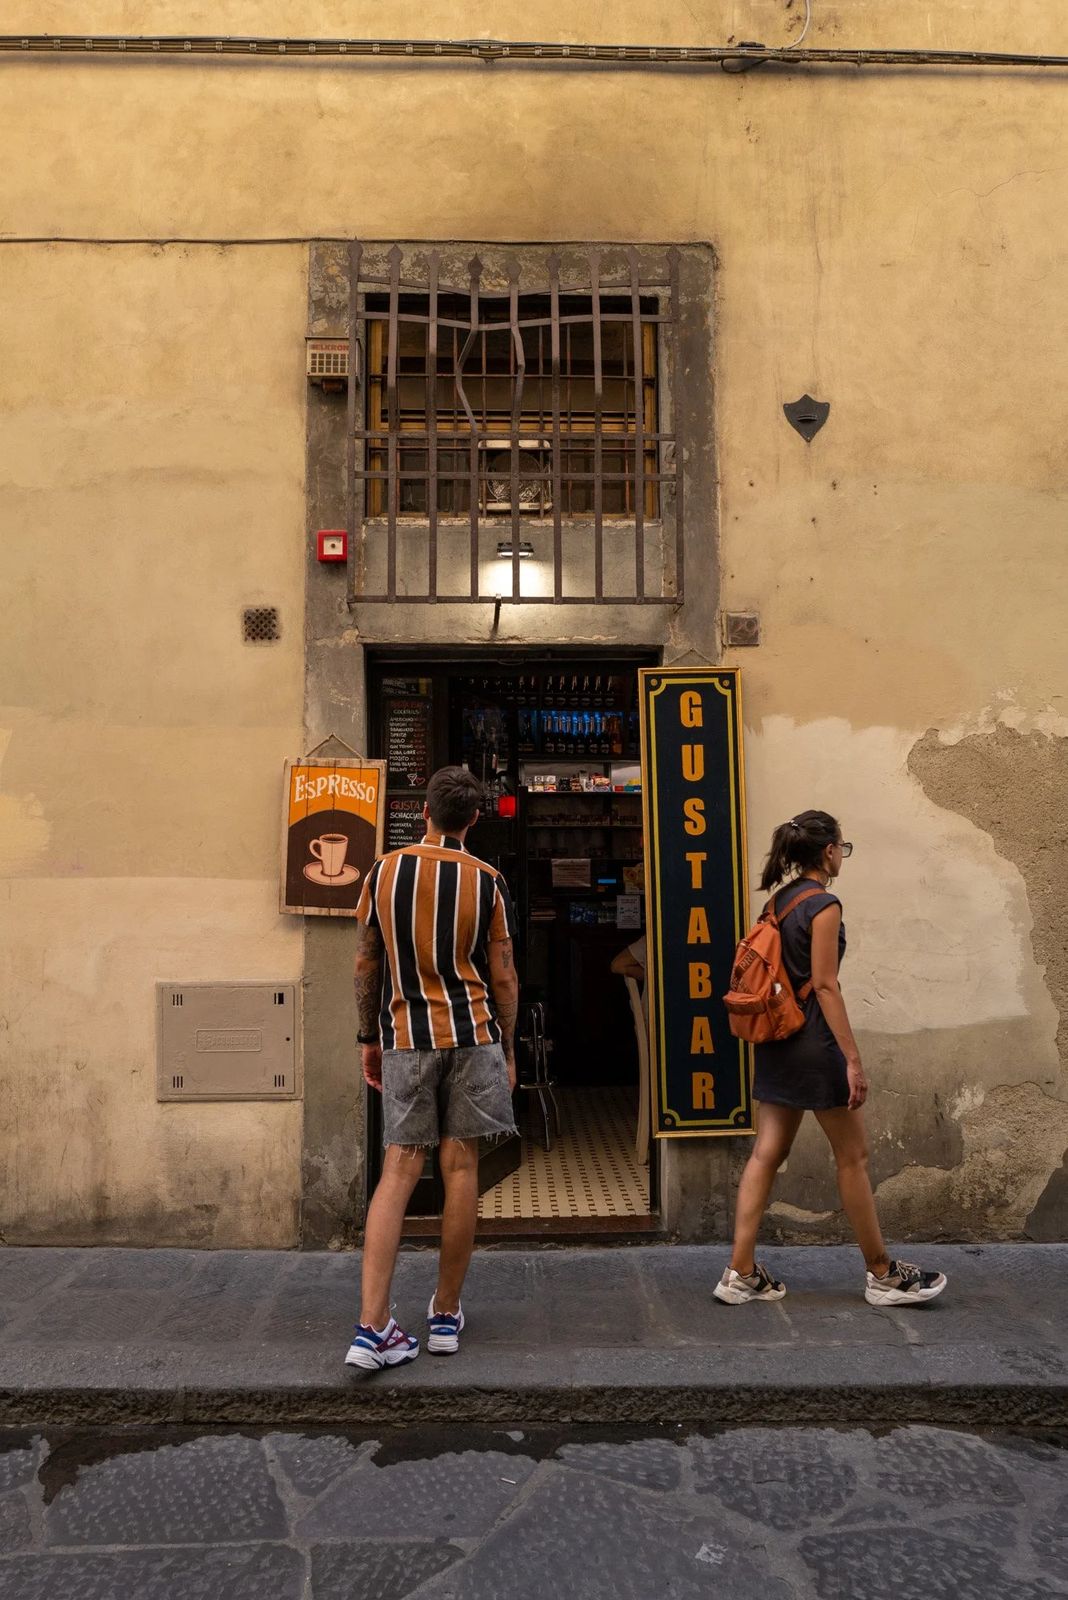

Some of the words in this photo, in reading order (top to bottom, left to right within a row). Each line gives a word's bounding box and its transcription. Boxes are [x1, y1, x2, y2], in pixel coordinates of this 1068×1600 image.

[294, 773, 376, 804] ESPRESSO
[390, 800, 421, 810] GUSTA
[679, 690, 716, 1110] GUSTABAR
